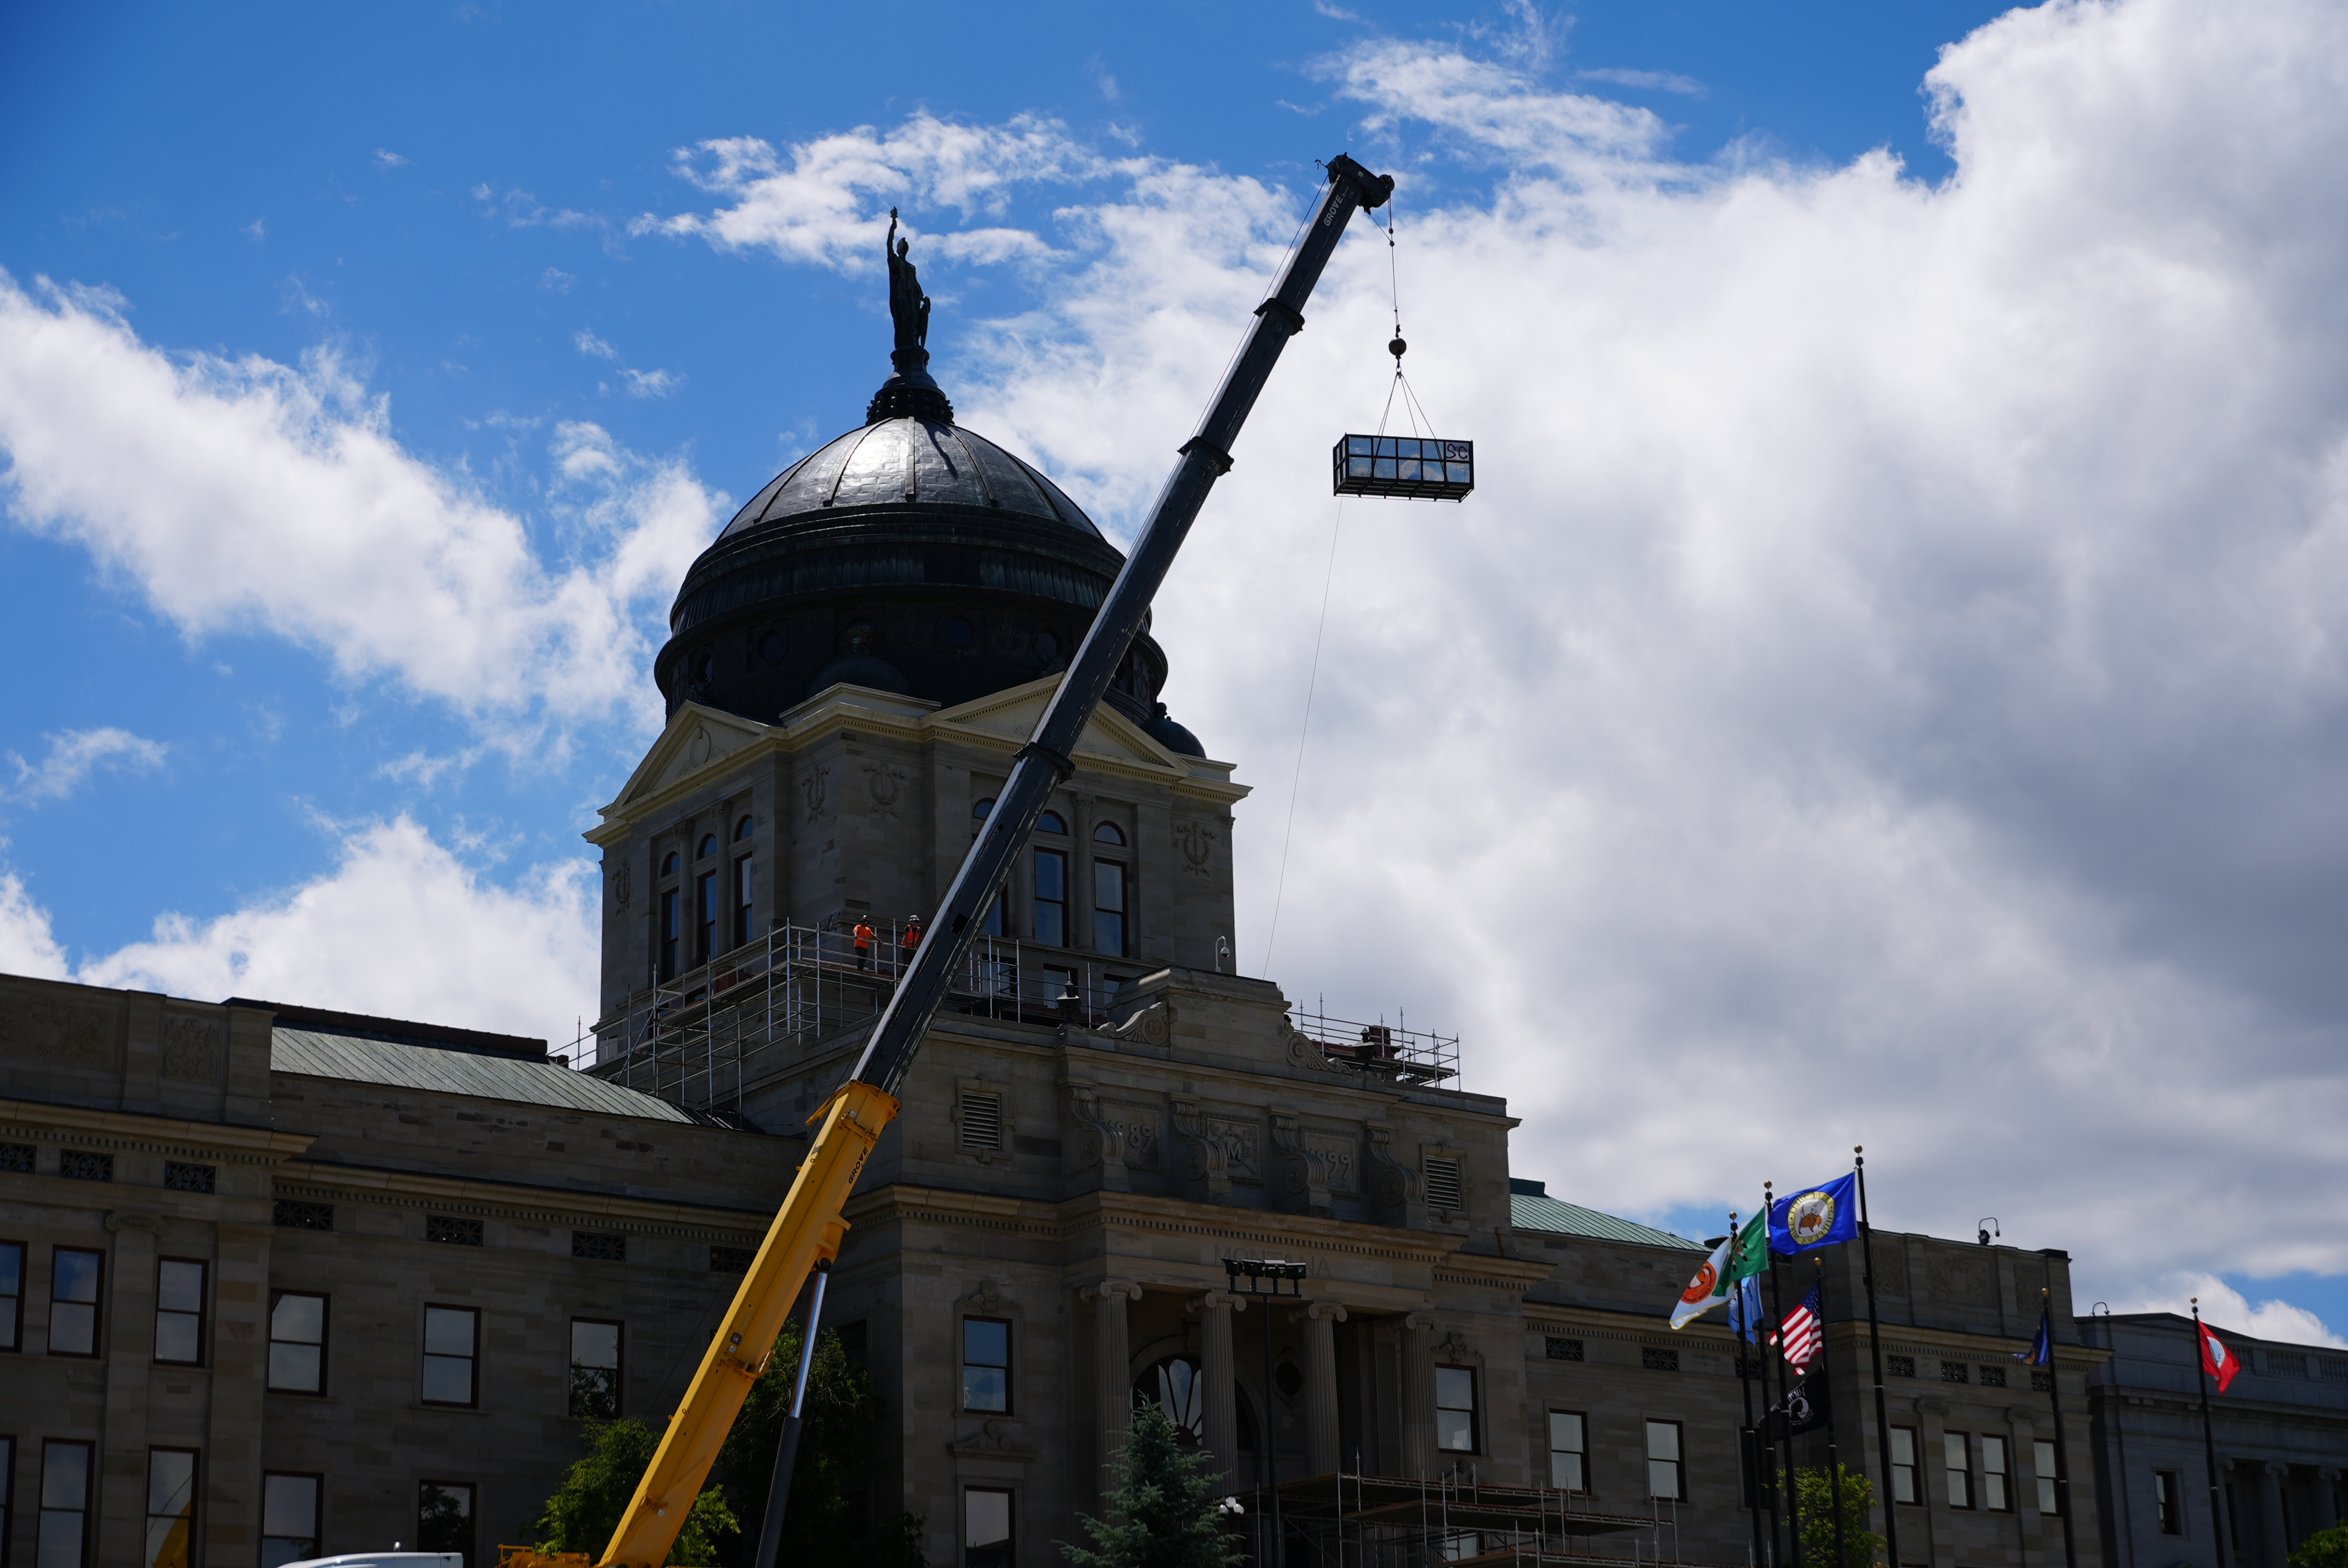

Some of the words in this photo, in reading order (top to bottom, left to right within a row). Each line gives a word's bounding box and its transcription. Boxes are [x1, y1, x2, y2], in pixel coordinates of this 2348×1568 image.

[1324, 194, 1343, 227] GROVE
[1445, 443, 1468, 459] SC
[1108, 1120, 1154, 1155] 889
[848, 1146, 868, 1184] GROVE
[1309, 1148, 1351, 1181] 999
